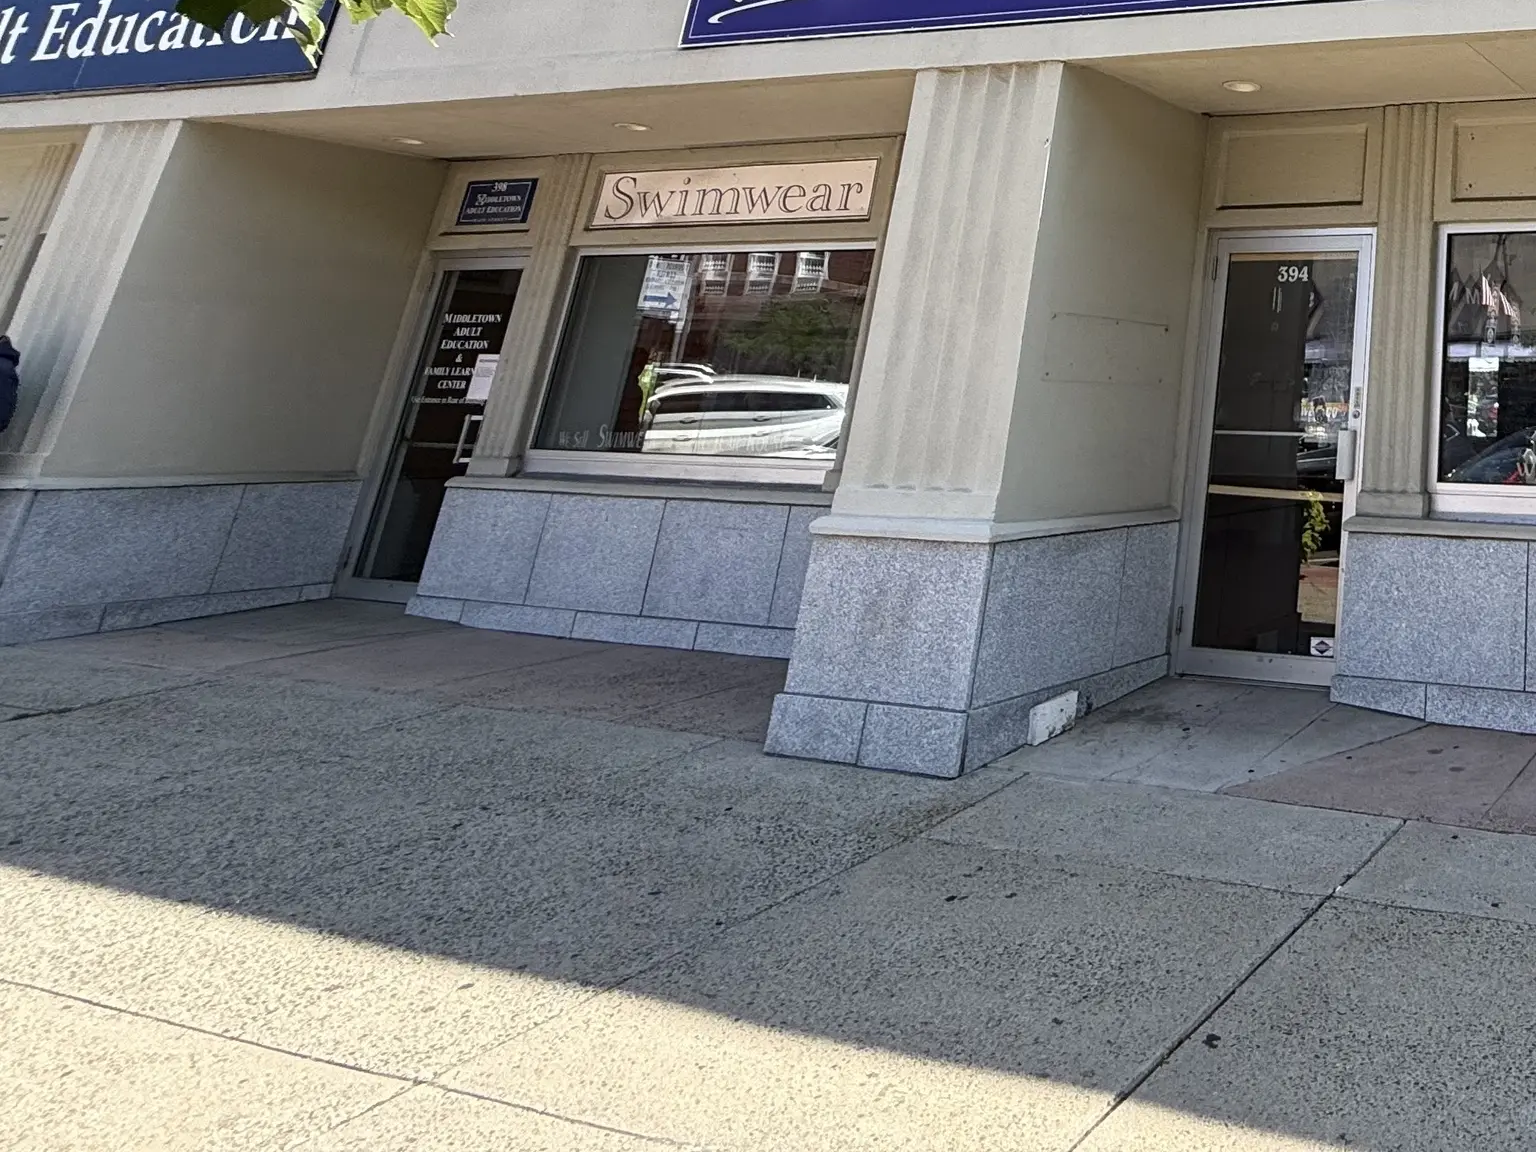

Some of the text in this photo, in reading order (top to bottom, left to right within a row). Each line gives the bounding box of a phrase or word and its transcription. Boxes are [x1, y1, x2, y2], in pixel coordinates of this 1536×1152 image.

[603, 176, 864, 220] Swimwear
[1277, 265, 1309, 282] 394
[443, 313, 503, 324] MIDDLETOWN
[453, 326, 484, 337] ADULT
[440, 339, 490, 350] EDUCATION
[455, 353, 463, 363] &
[437, 380, 467, 390] CENTER
